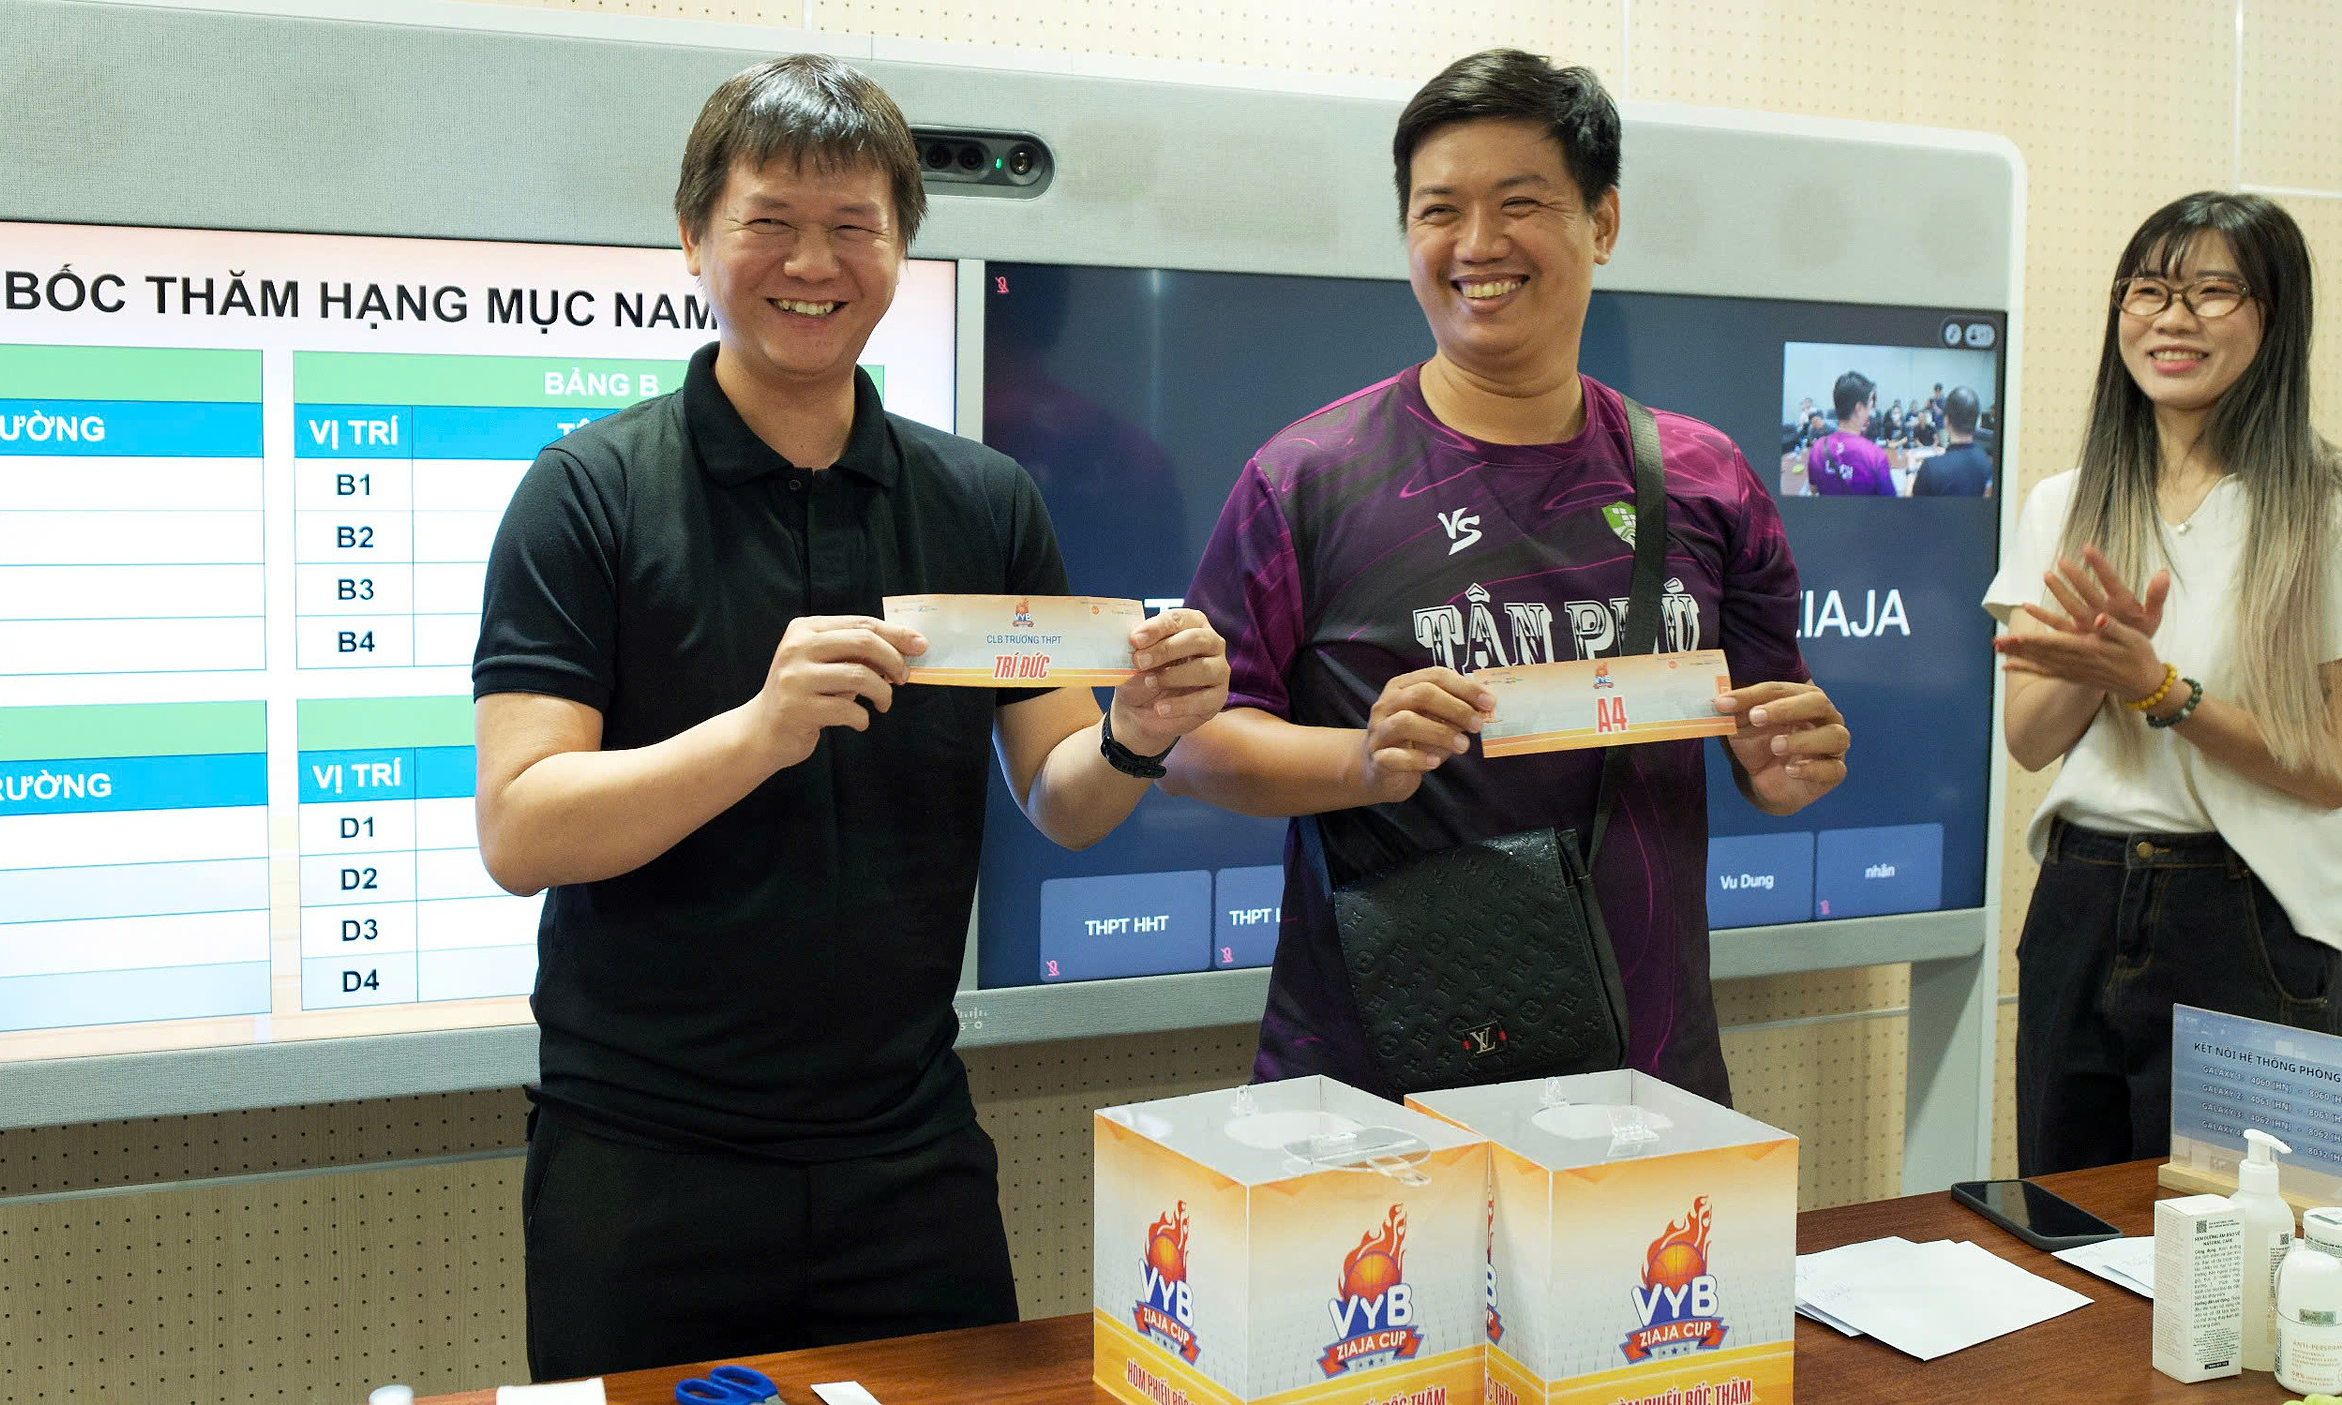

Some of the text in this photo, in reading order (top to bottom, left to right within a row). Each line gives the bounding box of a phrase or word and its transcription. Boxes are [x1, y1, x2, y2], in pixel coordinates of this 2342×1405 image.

[5, 264, 719, 334] BỐC THĂM HẠNG MỤC NAM
[544, 369, 659, 396] BẢNG B
[308, 415, 399, 450] VỊ TRÍ
[336, 474, 372, 496] B1
[336, 526, 374, 548] B2
[338, 579, 374, 600] B3
[1796, 589, 1911, 638] IAJA
[986, 634, 1003, 644] CLB
[1041, 636, 1062, 644] THPT
[1413, 583, 1554, 676] TÂN
[338, 631, 375, 652] B4
[994, 652, 1050, 679] TRÍ ĐỨC
[1597, 697, 1628, 733] A4
[312, 758, 401, 795] VỊ TRÍ
[340, 816, 375, 838] D1
[341, 867, 377, 890] D2
[1721, 873, 1774, 890] Vu Dung
[1085, 915, 1169, 936] THPT HHT
[1229, 908, 1272, 926] THPT
[342, 919, 378, 941] D3
[343, 969, 379, 992] D4
[2203, 1065, 2236, 1079] GALAXY
[2202, 1084, 2235, 1098] GALAXY
[2202, 1102, 2235, 1116] GALAXY
[2202, 1120, 2235, 1135] GALAXY
[1139, 1259, 1194, 1328] VYB
[1631, 1275, 1719, 1327] VYB
[1328, 1283, 1413, 1339] VYB
[1143, 1307, 1190, 1344] ZIAJA CUP
[1640, 1322, 1712, 1347] ZIAJA CUP
[1337, 1331, 1407, 1360] ZIAJA CUP
[1715, 1377, 1751, 1404] THĂM
